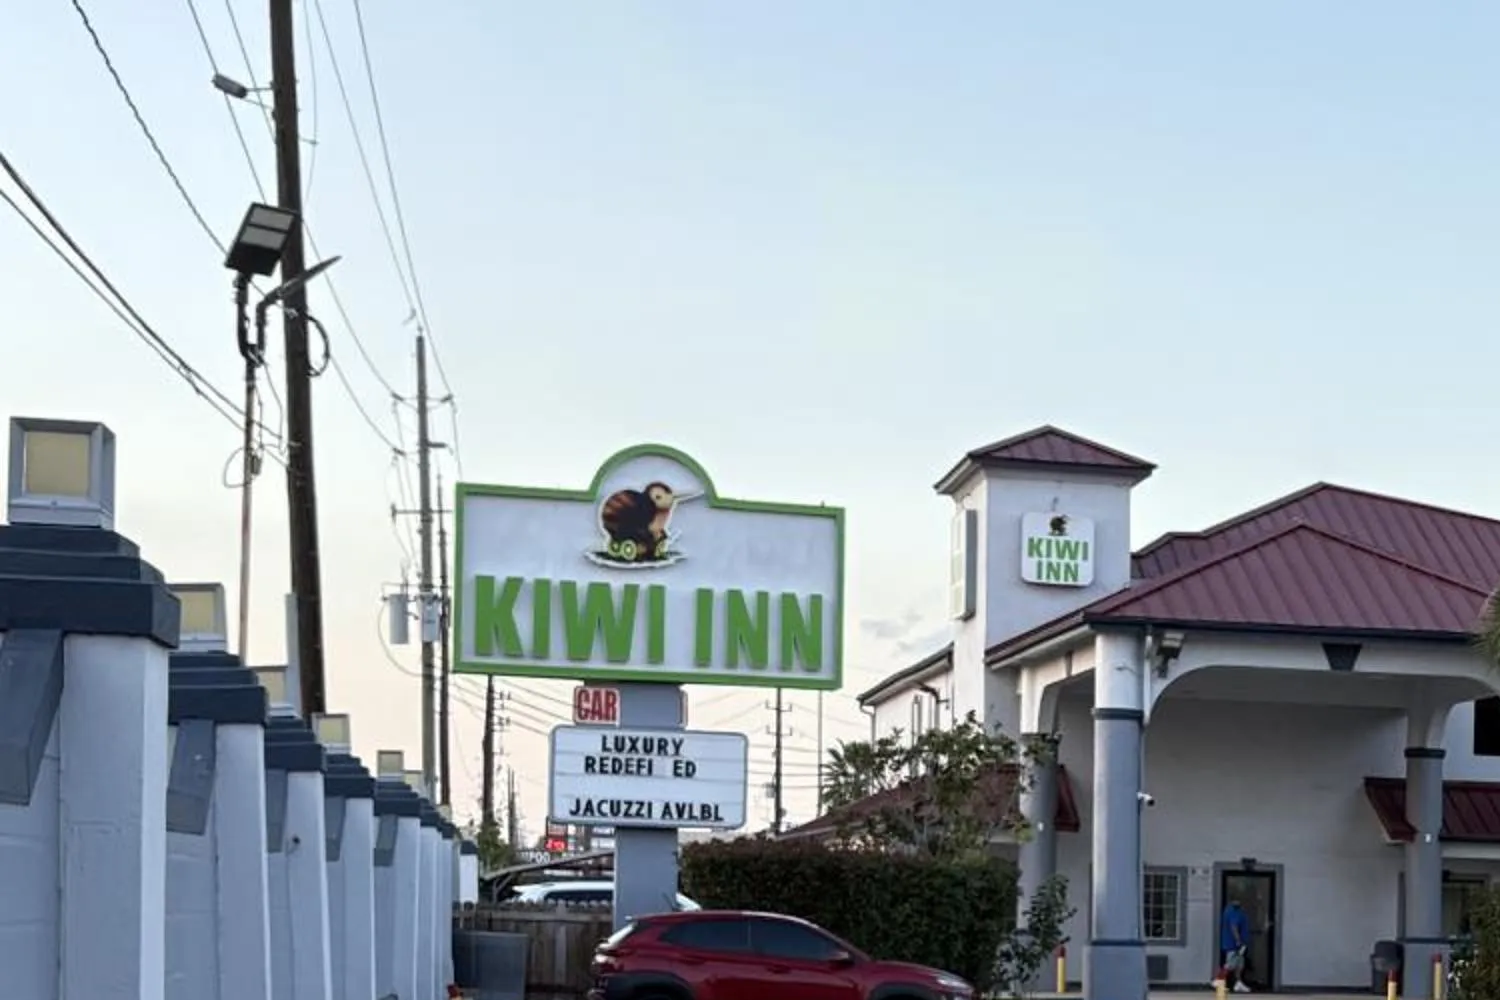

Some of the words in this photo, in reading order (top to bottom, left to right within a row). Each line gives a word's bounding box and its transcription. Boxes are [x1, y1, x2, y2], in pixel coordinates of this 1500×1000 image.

[1027, 536, 1089, 561] KIWI
[1036, 560, 1079, 583] INN
[474, 574, 666, 665] KIWI
[694, 588, 823, 671] INN
[601, 735, 684, 756] LUXURY
[569, 798, 653, 819] JACUZZI
[660, 803, 724, 822] AVLBL
